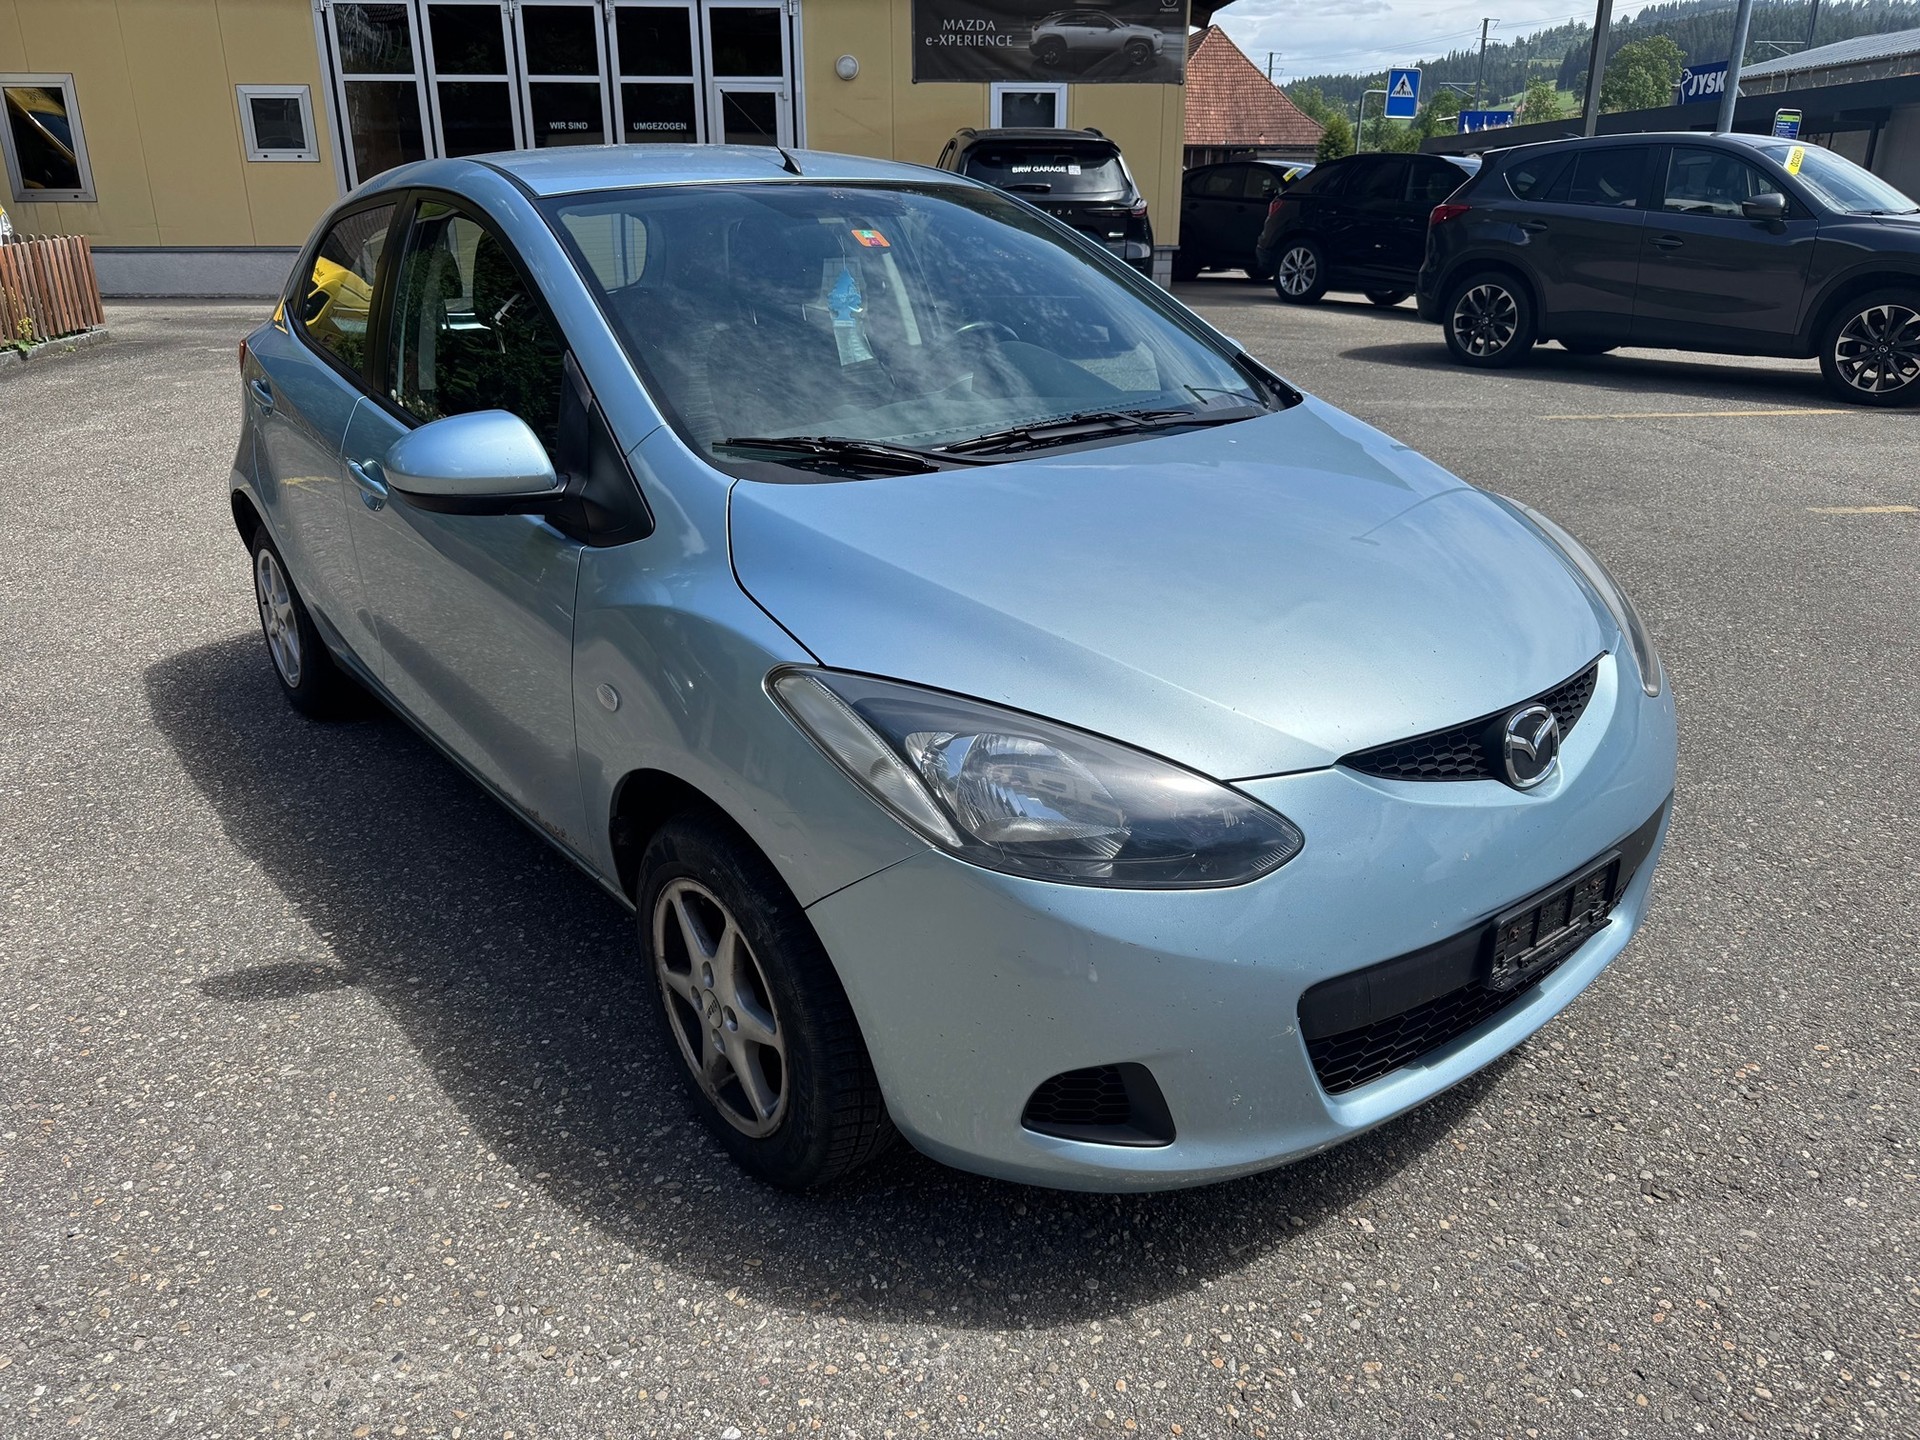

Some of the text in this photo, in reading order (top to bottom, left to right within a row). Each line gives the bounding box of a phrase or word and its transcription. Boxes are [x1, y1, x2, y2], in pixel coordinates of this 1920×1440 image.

[942, 19, 996, 32] MAZDA
[925, 34, 1013, 47] e-XPERIENCE
[1688, 70, 1728, 96] JYSK
[549, 121, 687, 130] WIR SIND UMGEZOGEN
[1011, 164, 1067, 173] BRW GARAGE
